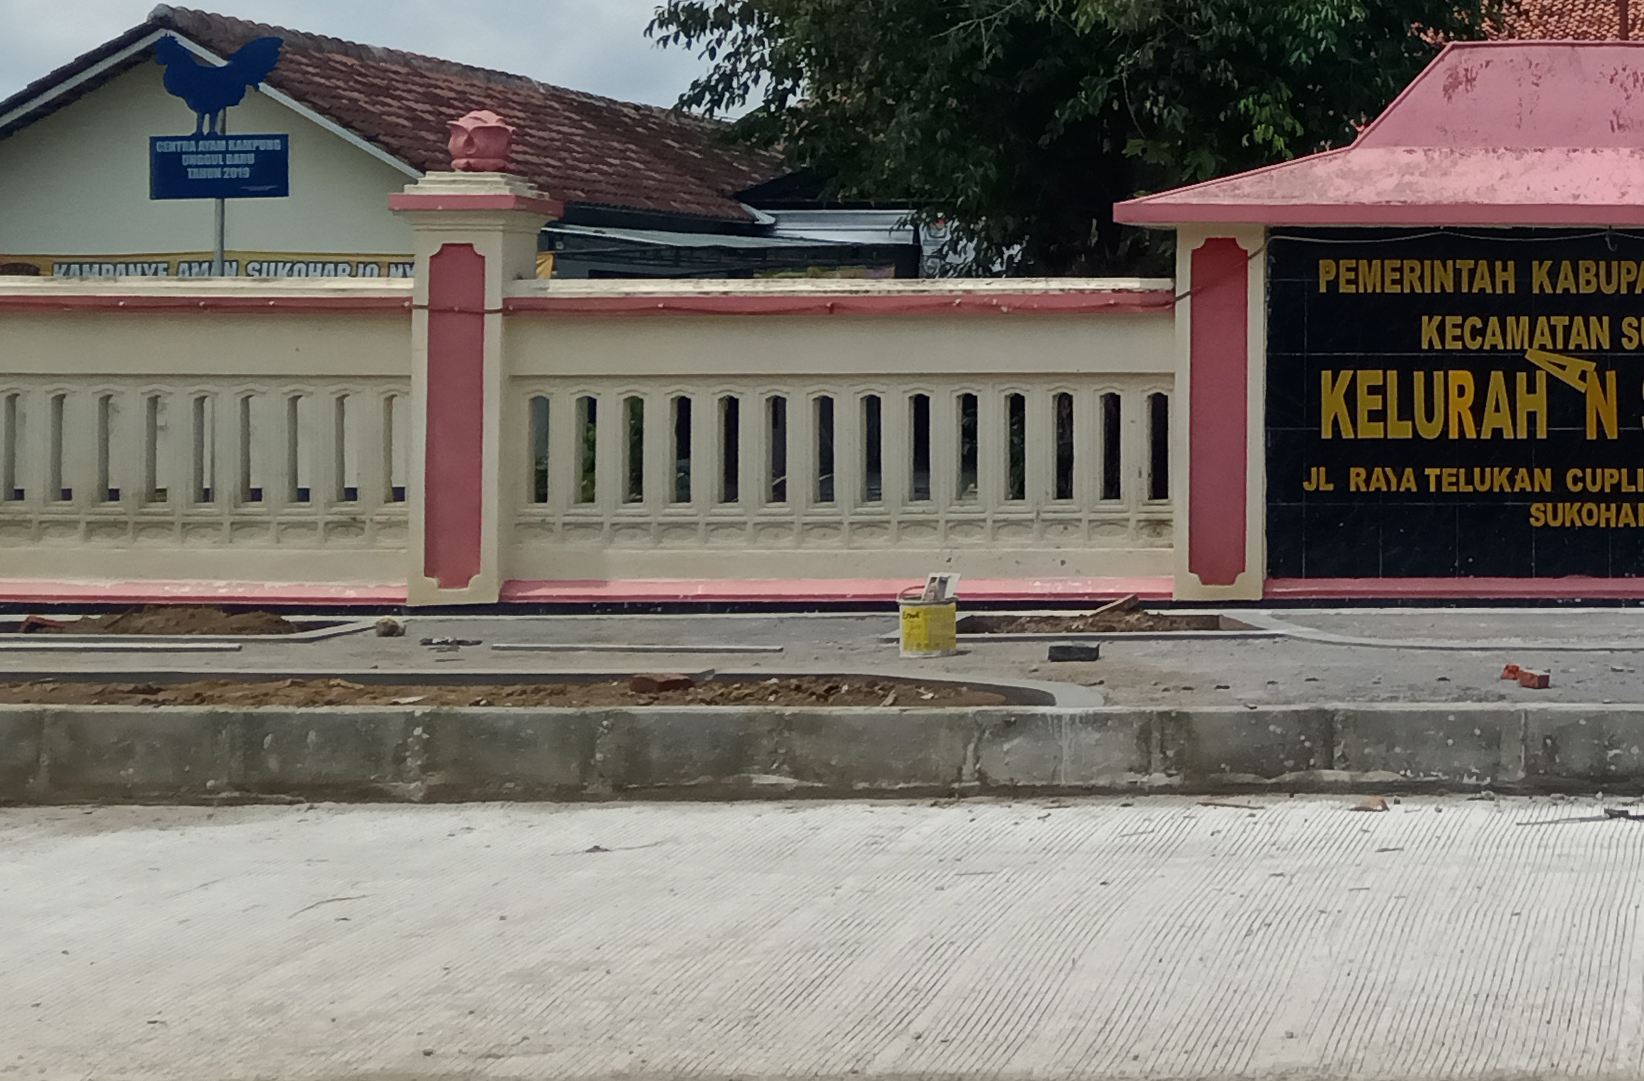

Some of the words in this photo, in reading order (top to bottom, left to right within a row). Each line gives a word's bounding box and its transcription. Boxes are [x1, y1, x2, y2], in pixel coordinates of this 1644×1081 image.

[198, 139, 226, 151] AYAM
[228, 139, 281, 150] KAMPUNG
[187, 167, 222, 179] TAHUN
[223, 167, 250, 179] 2019
[1318, 259, 1516, 294] PEMERINTAH
[1421, 315, 1610, 350] KECAMATAN
[1303, 466, 1334, 491] JL
[1349, 467, 1418, 492] RAYA
[1425, 467, 1552, 493] TELUKAN
